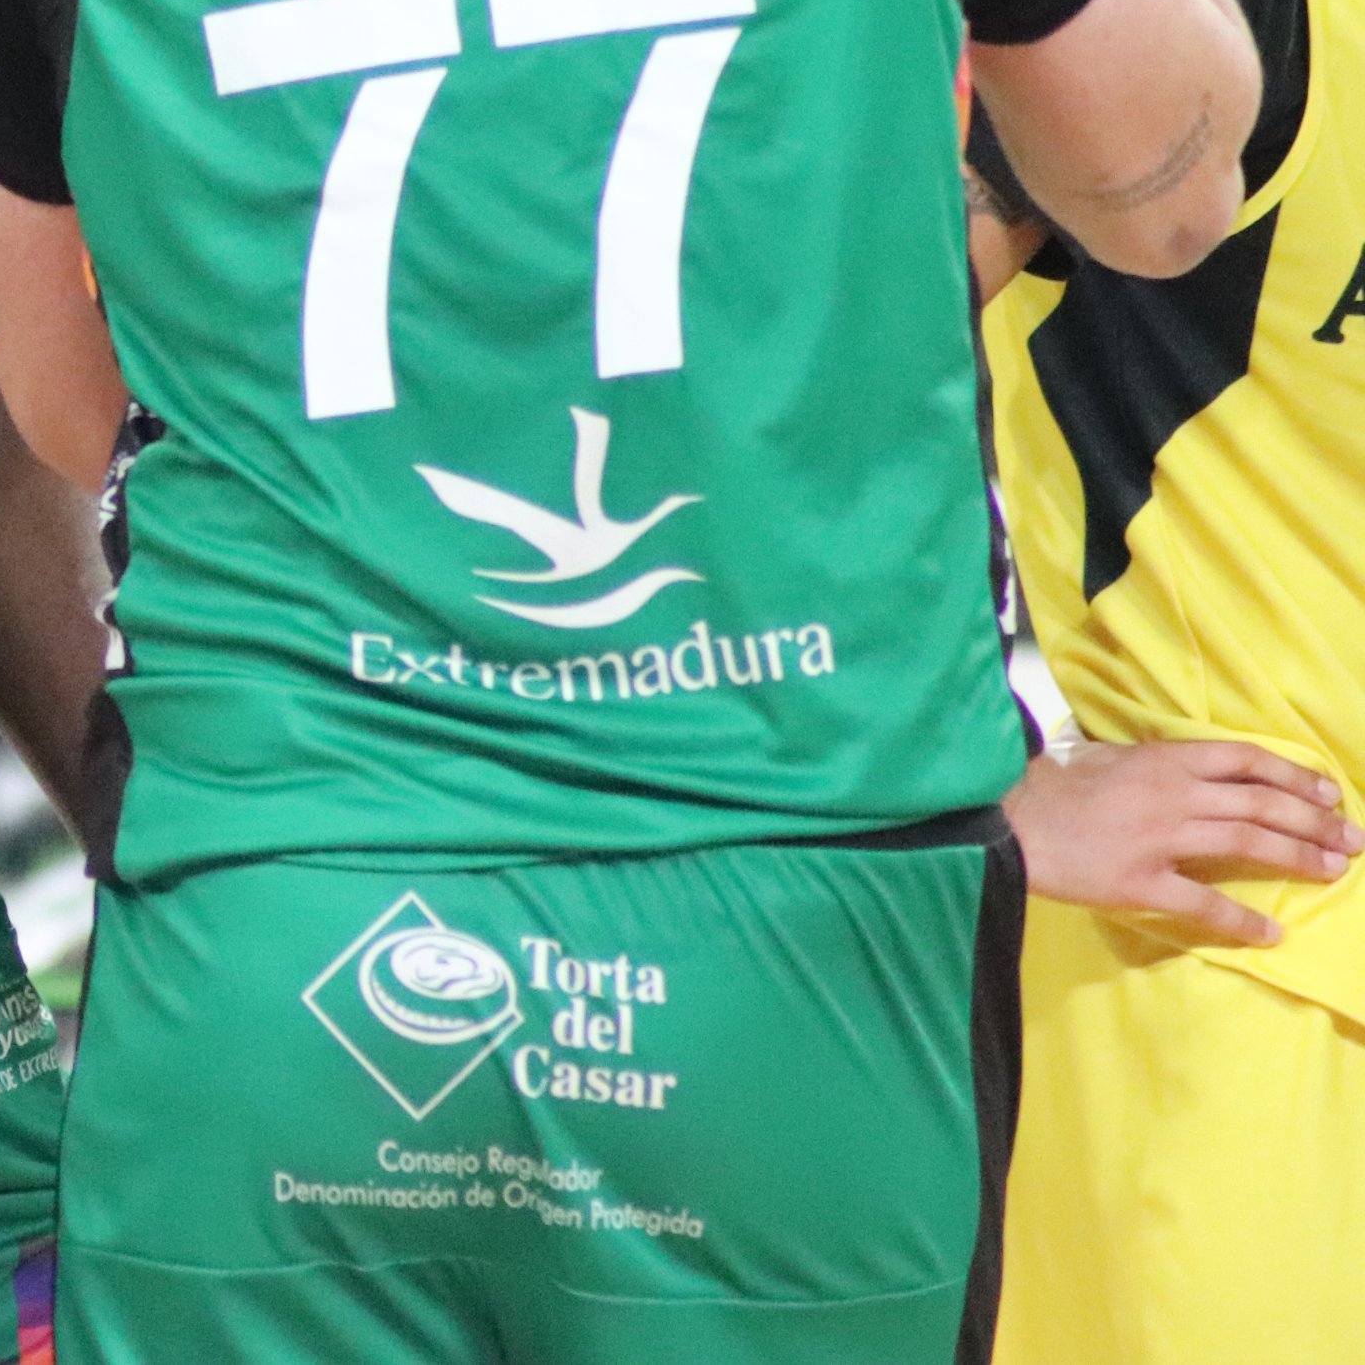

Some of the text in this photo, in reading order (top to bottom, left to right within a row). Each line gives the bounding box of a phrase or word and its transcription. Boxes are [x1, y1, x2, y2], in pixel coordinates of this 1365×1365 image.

[350, 620, 835, 703] Extremadura
[520, 936, 667, 1005] Torta
[552, 986, 633, 1055] del
[513, 1044, 677, 1110] Casar
[377, 1140, 480, 1180] Consejo
[274, 1171, 457, 1209] Denominación
[464, 1181, 495, 1209] de
[589, 1198, 705, 1238] Protegida
